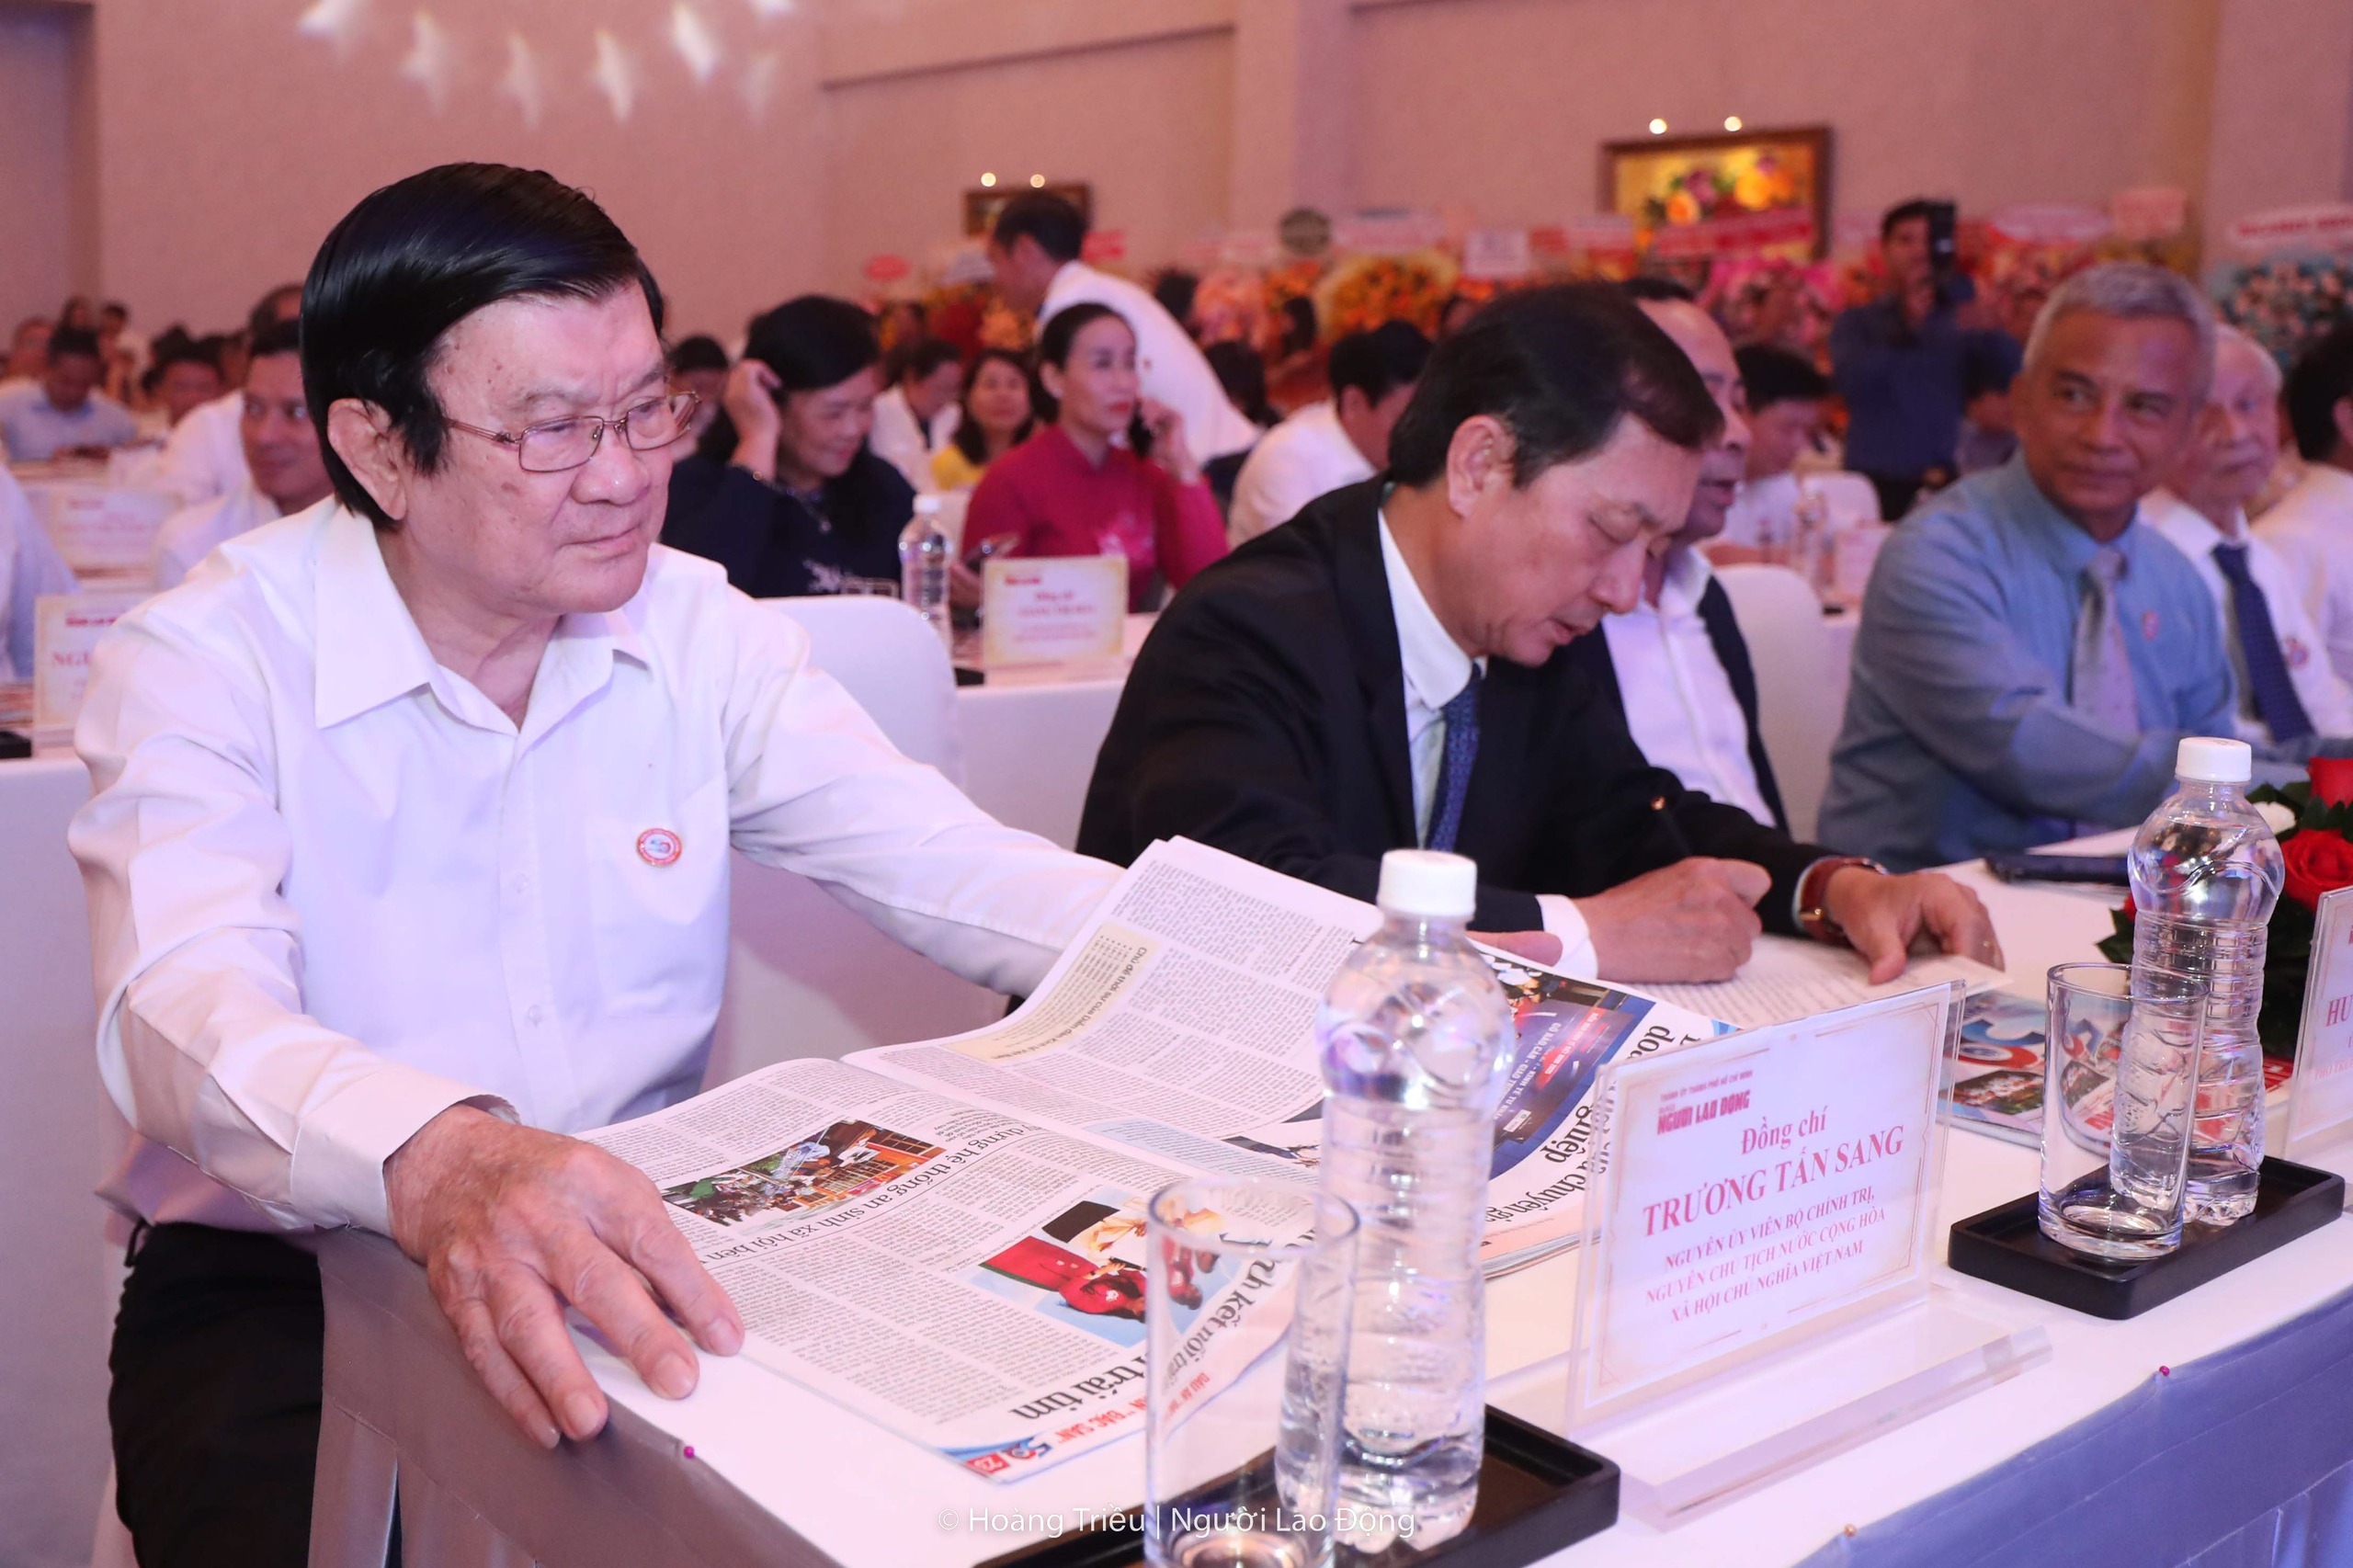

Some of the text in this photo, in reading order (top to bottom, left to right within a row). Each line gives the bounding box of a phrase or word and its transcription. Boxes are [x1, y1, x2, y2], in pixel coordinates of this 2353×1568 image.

[1695, 1099, 1718, 1123] LAO
[969, 1127, 1025, 1150] dựng
[1741, 1106, 1828, 1155] Đồng chí
[946, 1148, 981, 1164] hệ
[886, 1163, 951, 1196] thống
[1509, 1172, 1587, 1218] chuyên
[1643, 1125, 1904, 1237] TRƯƠNG TẤN SANG
[817, 1207, 866, 1228] sinh
[862, 1194, 893, 1210] an
[752, 1233, 795, 1250] hội
[789, 1224, 820, 1238] xã
[1665, 1236, 1726, 1270] NGUYÊN
[1749, 1215, 1782, 1241] VIÊN
[1784, 1210, 1803, 1231] BỘ
[1807, 1193, 1847, 1222] CHÍNH
[1744, 1245, 1776, 1273] TỊCH
[1820, 1216, 1856, 1244] CỘNG
[1694, 1289, 1721, 1315] HỘI
[1756, 1261, 1799, 1291] NGHĨA
[1802, 1250, 1833, 1274] VIỆT
[1834, 1239, 1864, 1264] NAM
[1215, 1290, 1256, 1328] kết
[1008, 1366, 1145, 1420] trái tim
